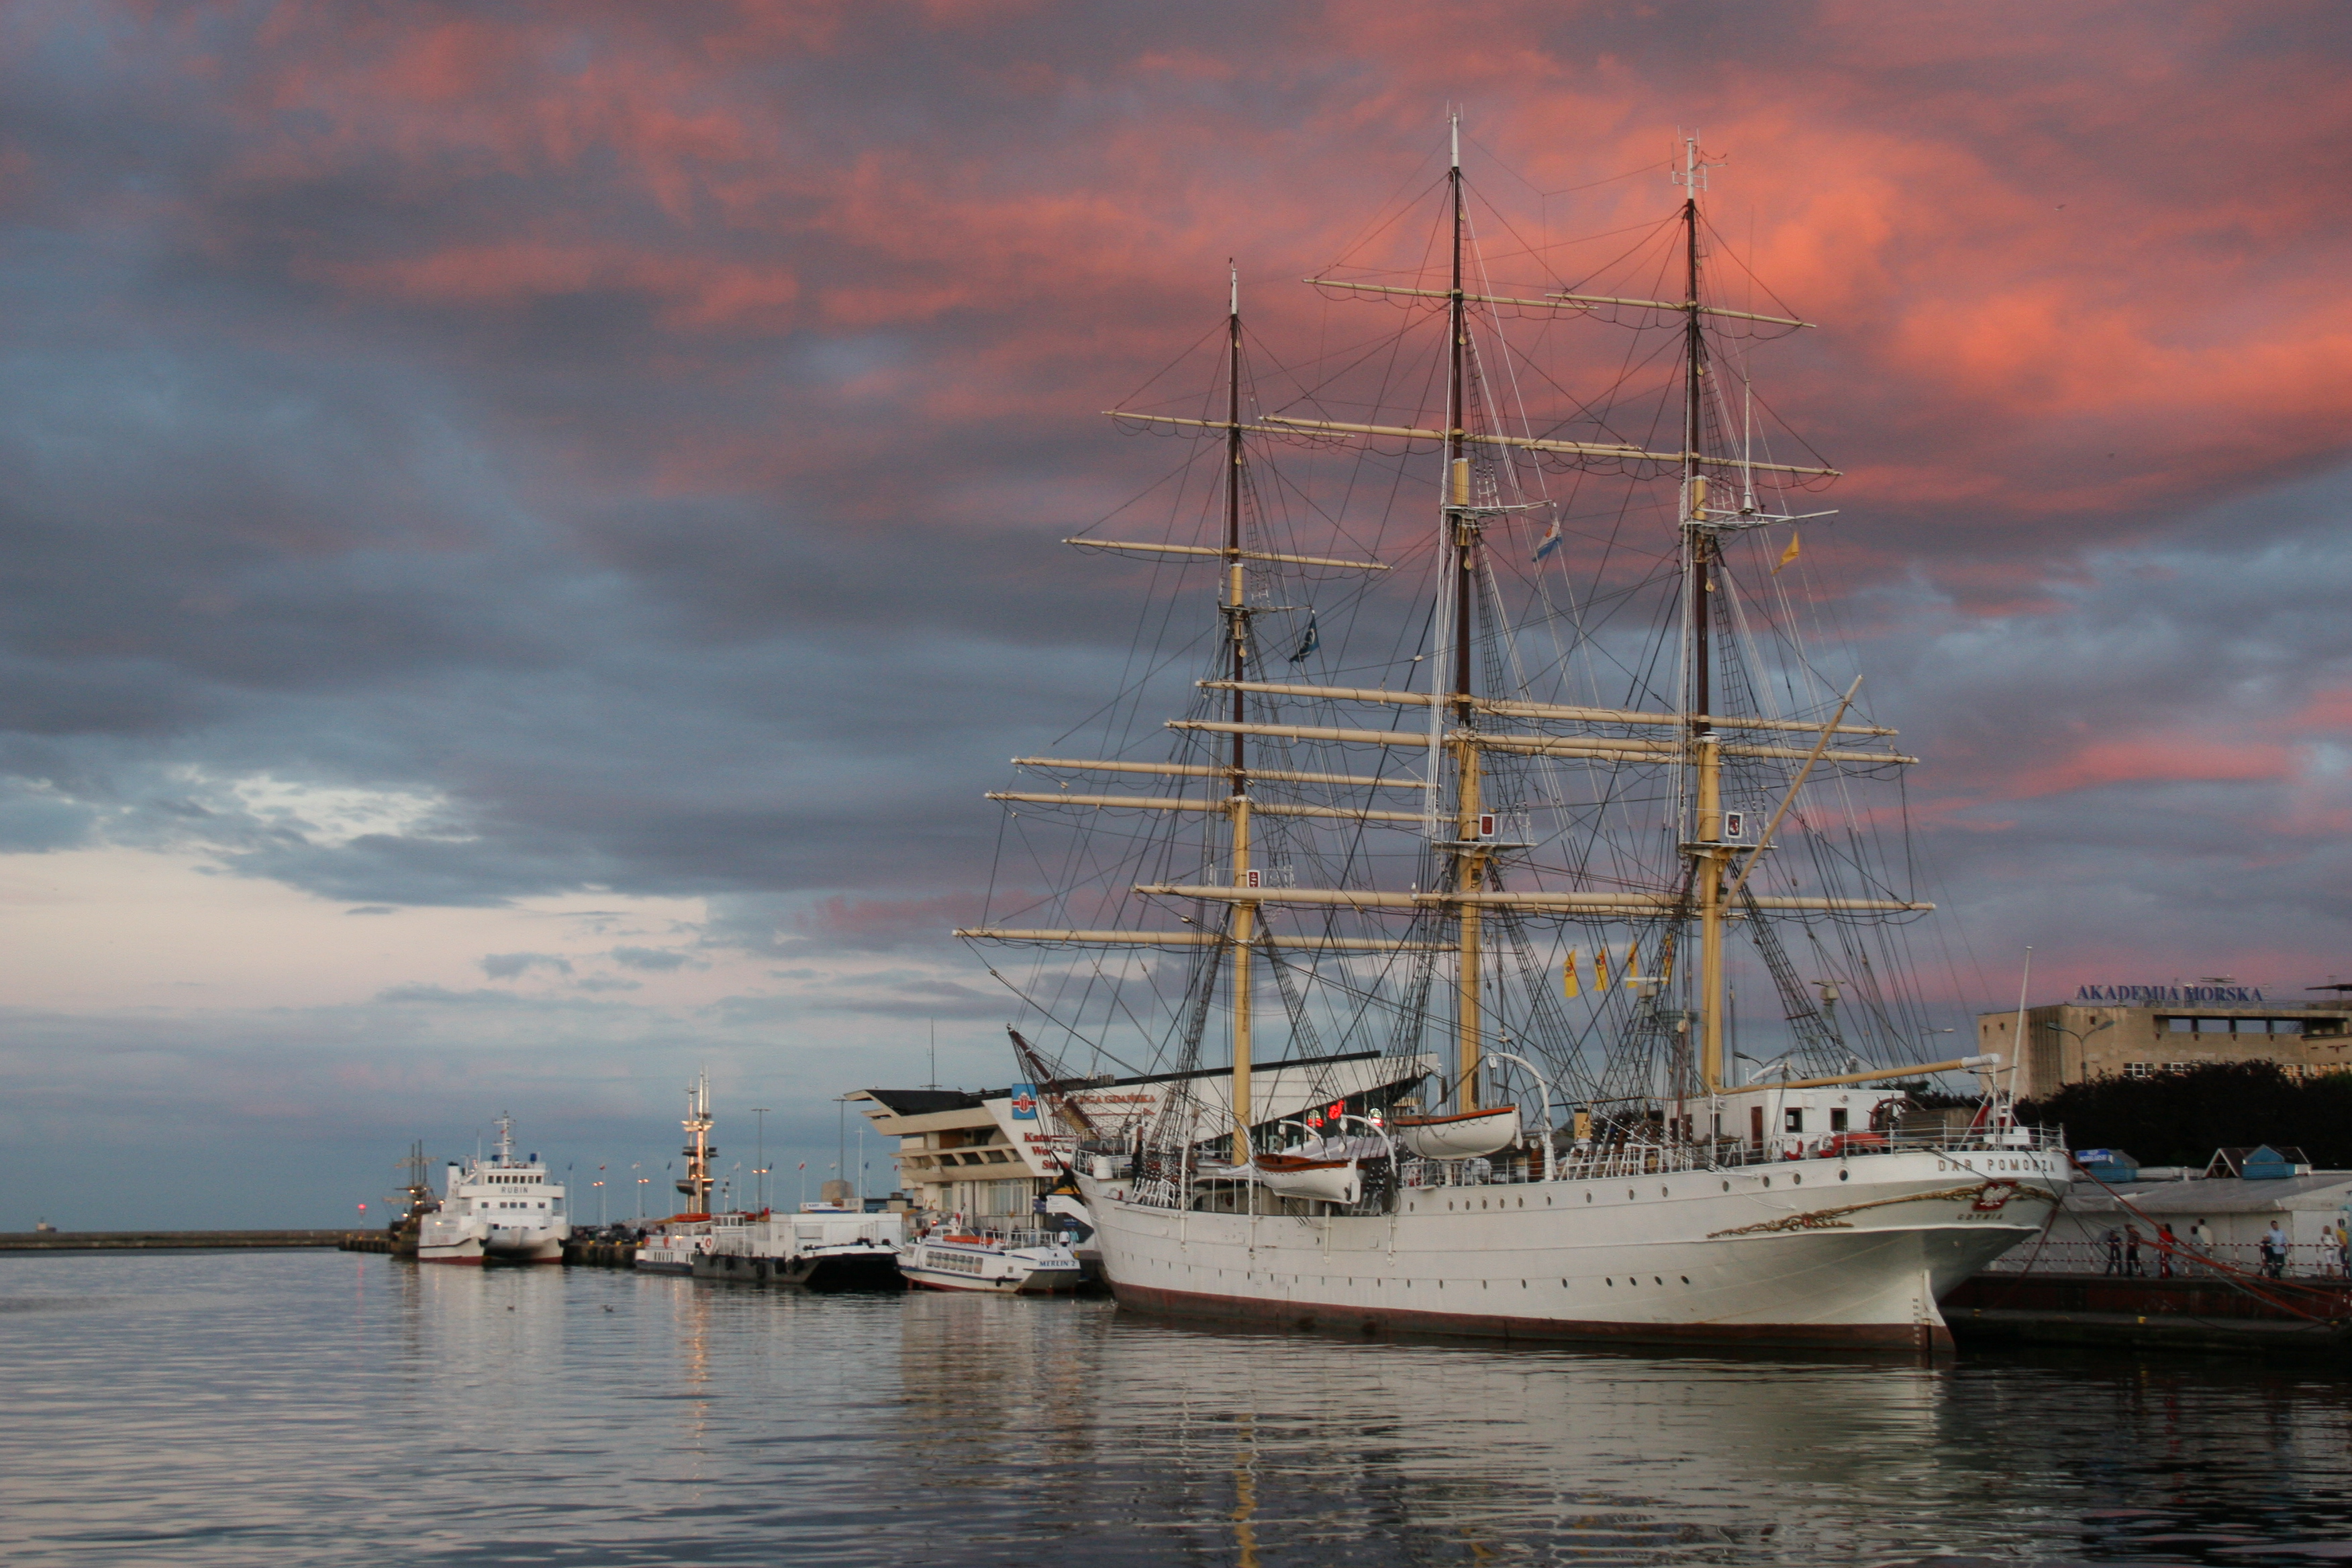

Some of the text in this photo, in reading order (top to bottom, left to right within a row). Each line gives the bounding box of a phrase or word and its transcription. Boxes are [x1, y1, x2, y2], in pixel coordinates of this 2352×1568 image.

[2077, 985, 2263, 1001] AKADEMIA MORSKA
[1938, 1158, 2055, 1173] DAR POMORZA
